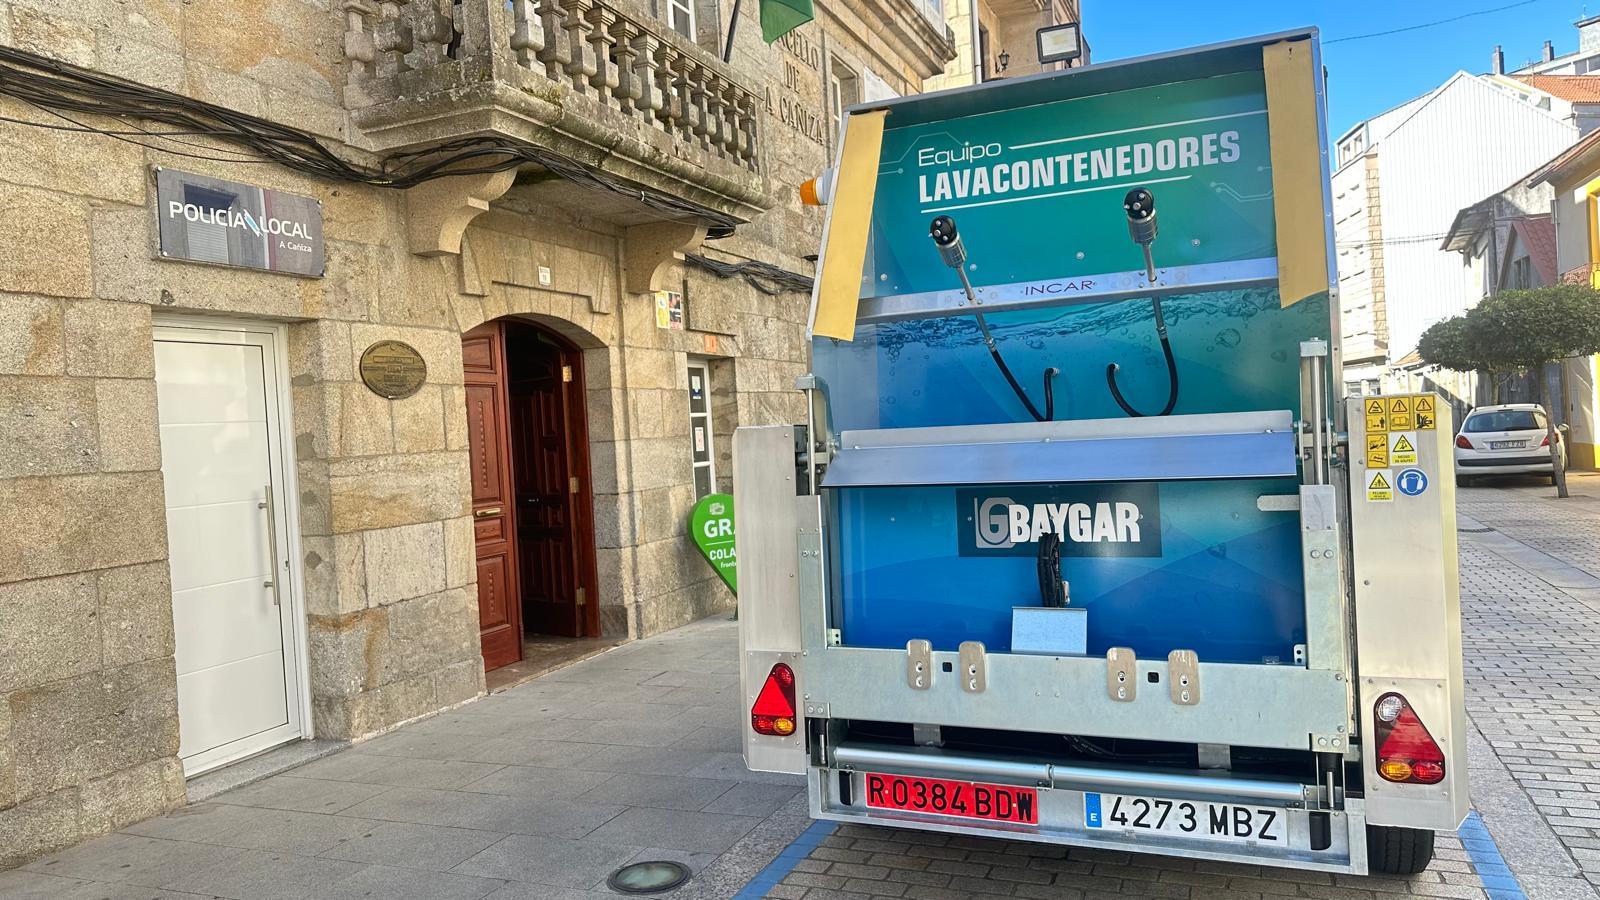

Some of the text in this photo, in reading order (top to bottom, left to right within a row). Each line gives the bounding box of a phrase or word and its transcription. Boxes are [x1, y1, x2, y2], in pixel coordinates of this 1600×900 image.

[785, 61, 801, 94] DE
[765, 86, 774, 116] A
[918, 141, 1002, 167] Equipo
[918, 129, 1241, 204] LAVACONTENEDORES
[169, 200, 313, 240] POLICÍA LOCAL
[279, 240, 312, 253] A Cañiza
[1025, 280, 1094, 296] INCAR
[704, 518, 736, 538] GR
[1008, 502, 1141, 543] BAYGAR
[1090, 796, 1277, 841] E 4273 MBZ
